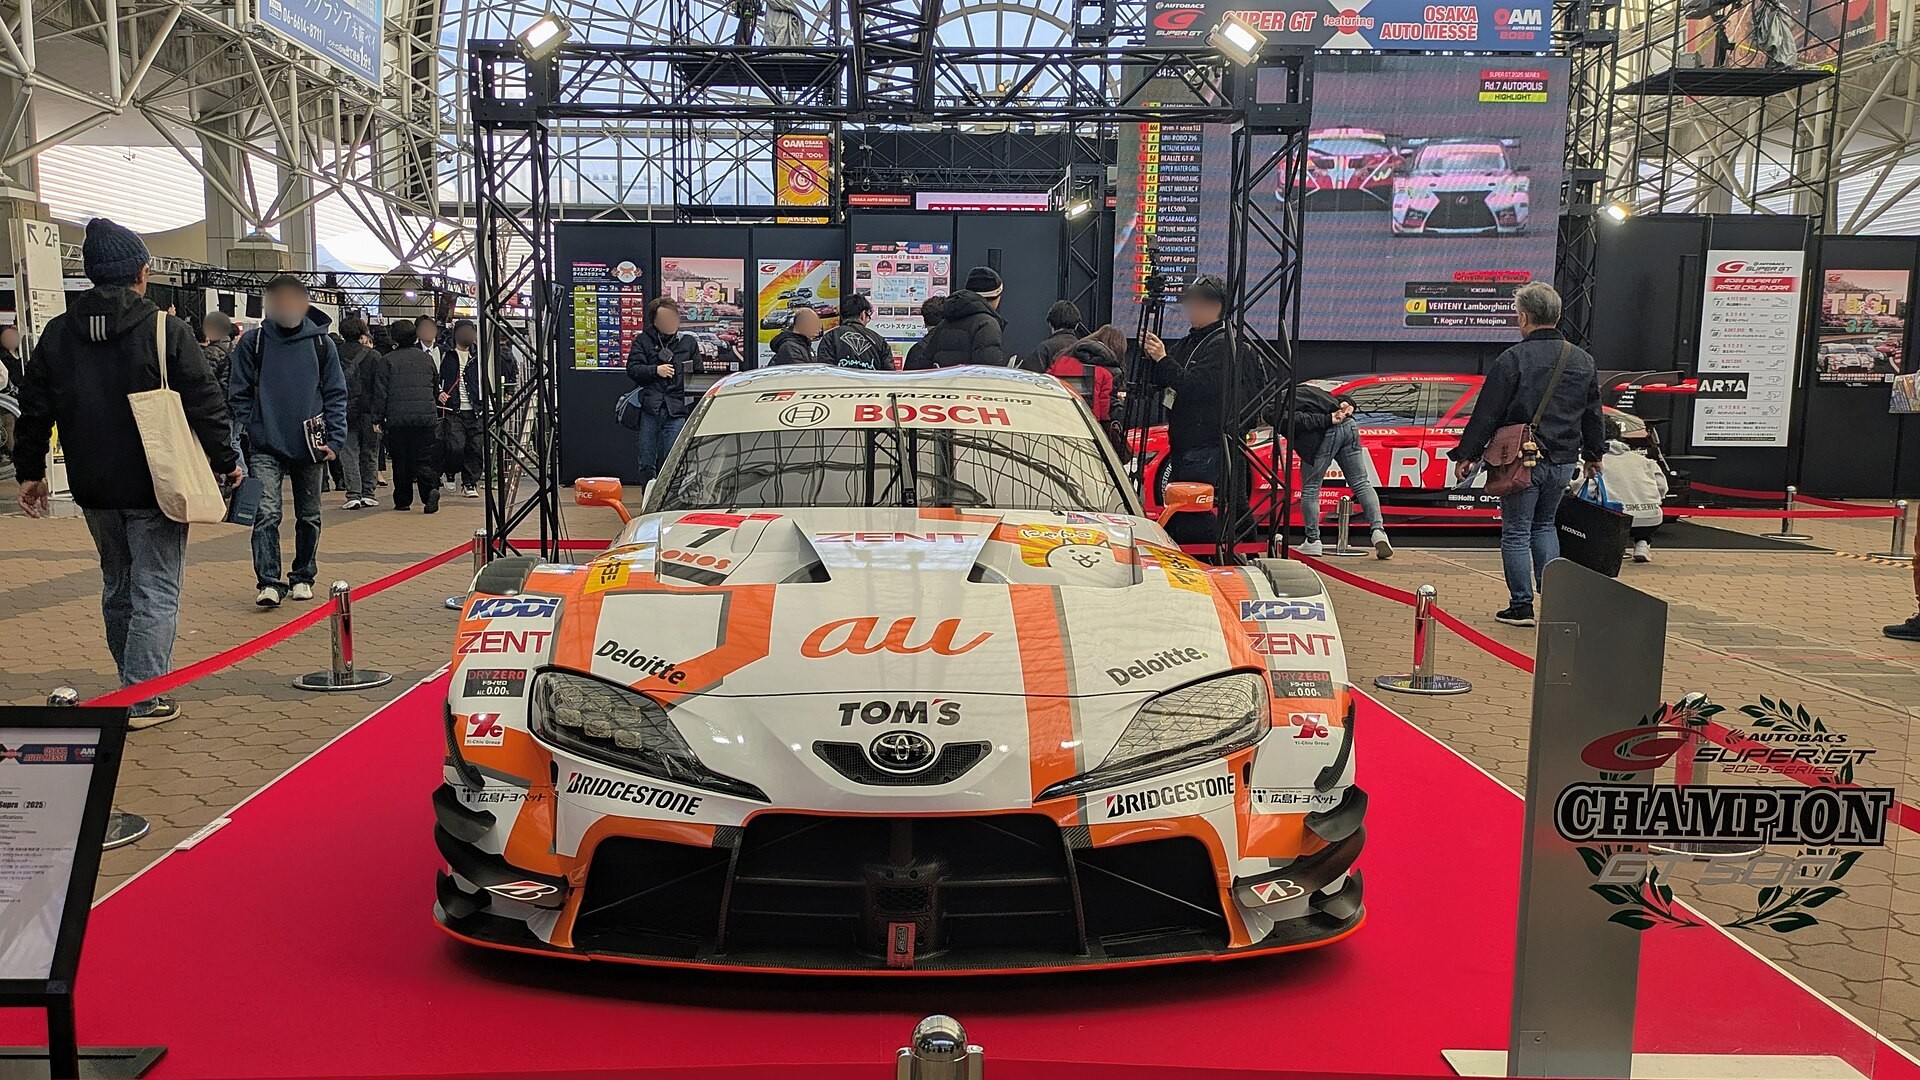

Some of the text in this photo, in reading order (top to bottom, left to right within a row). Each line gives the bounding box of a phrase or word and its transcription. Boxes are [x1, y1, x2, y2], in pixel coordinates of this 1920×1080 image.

[1288, 11, 1317, 31] GT
[1323, 15, 1374, 29] featuring
[1424, 5, 1479, 23] OSAKA
[1494, 8, 1542, 25] OAM
[1380, 23, 1478, 41] AUTO MESSE
[1485, 81, 1543, 91] Rd.7 AUTOPOLIS
[782, 140, 804, 148] OAM
[44, 226, 58, 248] 2F
[1413, 302, 1510, 312] 0 VENTENY Lamborghini
[1440, 317, 1463, 325] Kogure
[1476, 317, 1507, 326] Motojima
[1699, 380, 1747, 391] ARTA
[887, 392, 959, 400] GAZOO
[966, 394, 1032, 405] Racing
[854, 404, 1012, 426] BOSCH
[1459, 494, 1475, 502] Holts
[685, 528, 731, 549] 1
[815, 533, 979, 544] ZENT
[1020, 529, 1092, 540] にゃんこ
[1561, 525, 1587, 540] HONDA
[656, 549, 731, 570] ONOS
[467, 598, 561, 620] KDDI
[1241, 600, 1327, 622] KDDI
[458, 631, 552, 655] ZENT
[800, 616, 994, 659] au
[1246, 633, 1336, 656] ZENT
[595, 640, 687, 688] Deloitte.
[1105, 646, 1209, 687] Deloitte.
[468, 671, 525, 680] DRY ZERO
[1272, 672, 1329, 681] DRY ZERO
[1749, 733, 1848, 743] AUTOBACS
[1693, 747, 1877, 765] SUPER GT
[1722, 765, 1838, 775] 2025 SERIES
[478, 793, 546, 803] 広島トヨペット
[566, 772, 703, 816] BRIDGESTONE
[1107, 775, 1235, 819] BRIDGESTONE
[1271, 793, 1337, 804] 広島トヨペット
[1553, 782, 1896, 847] CHAMPION
